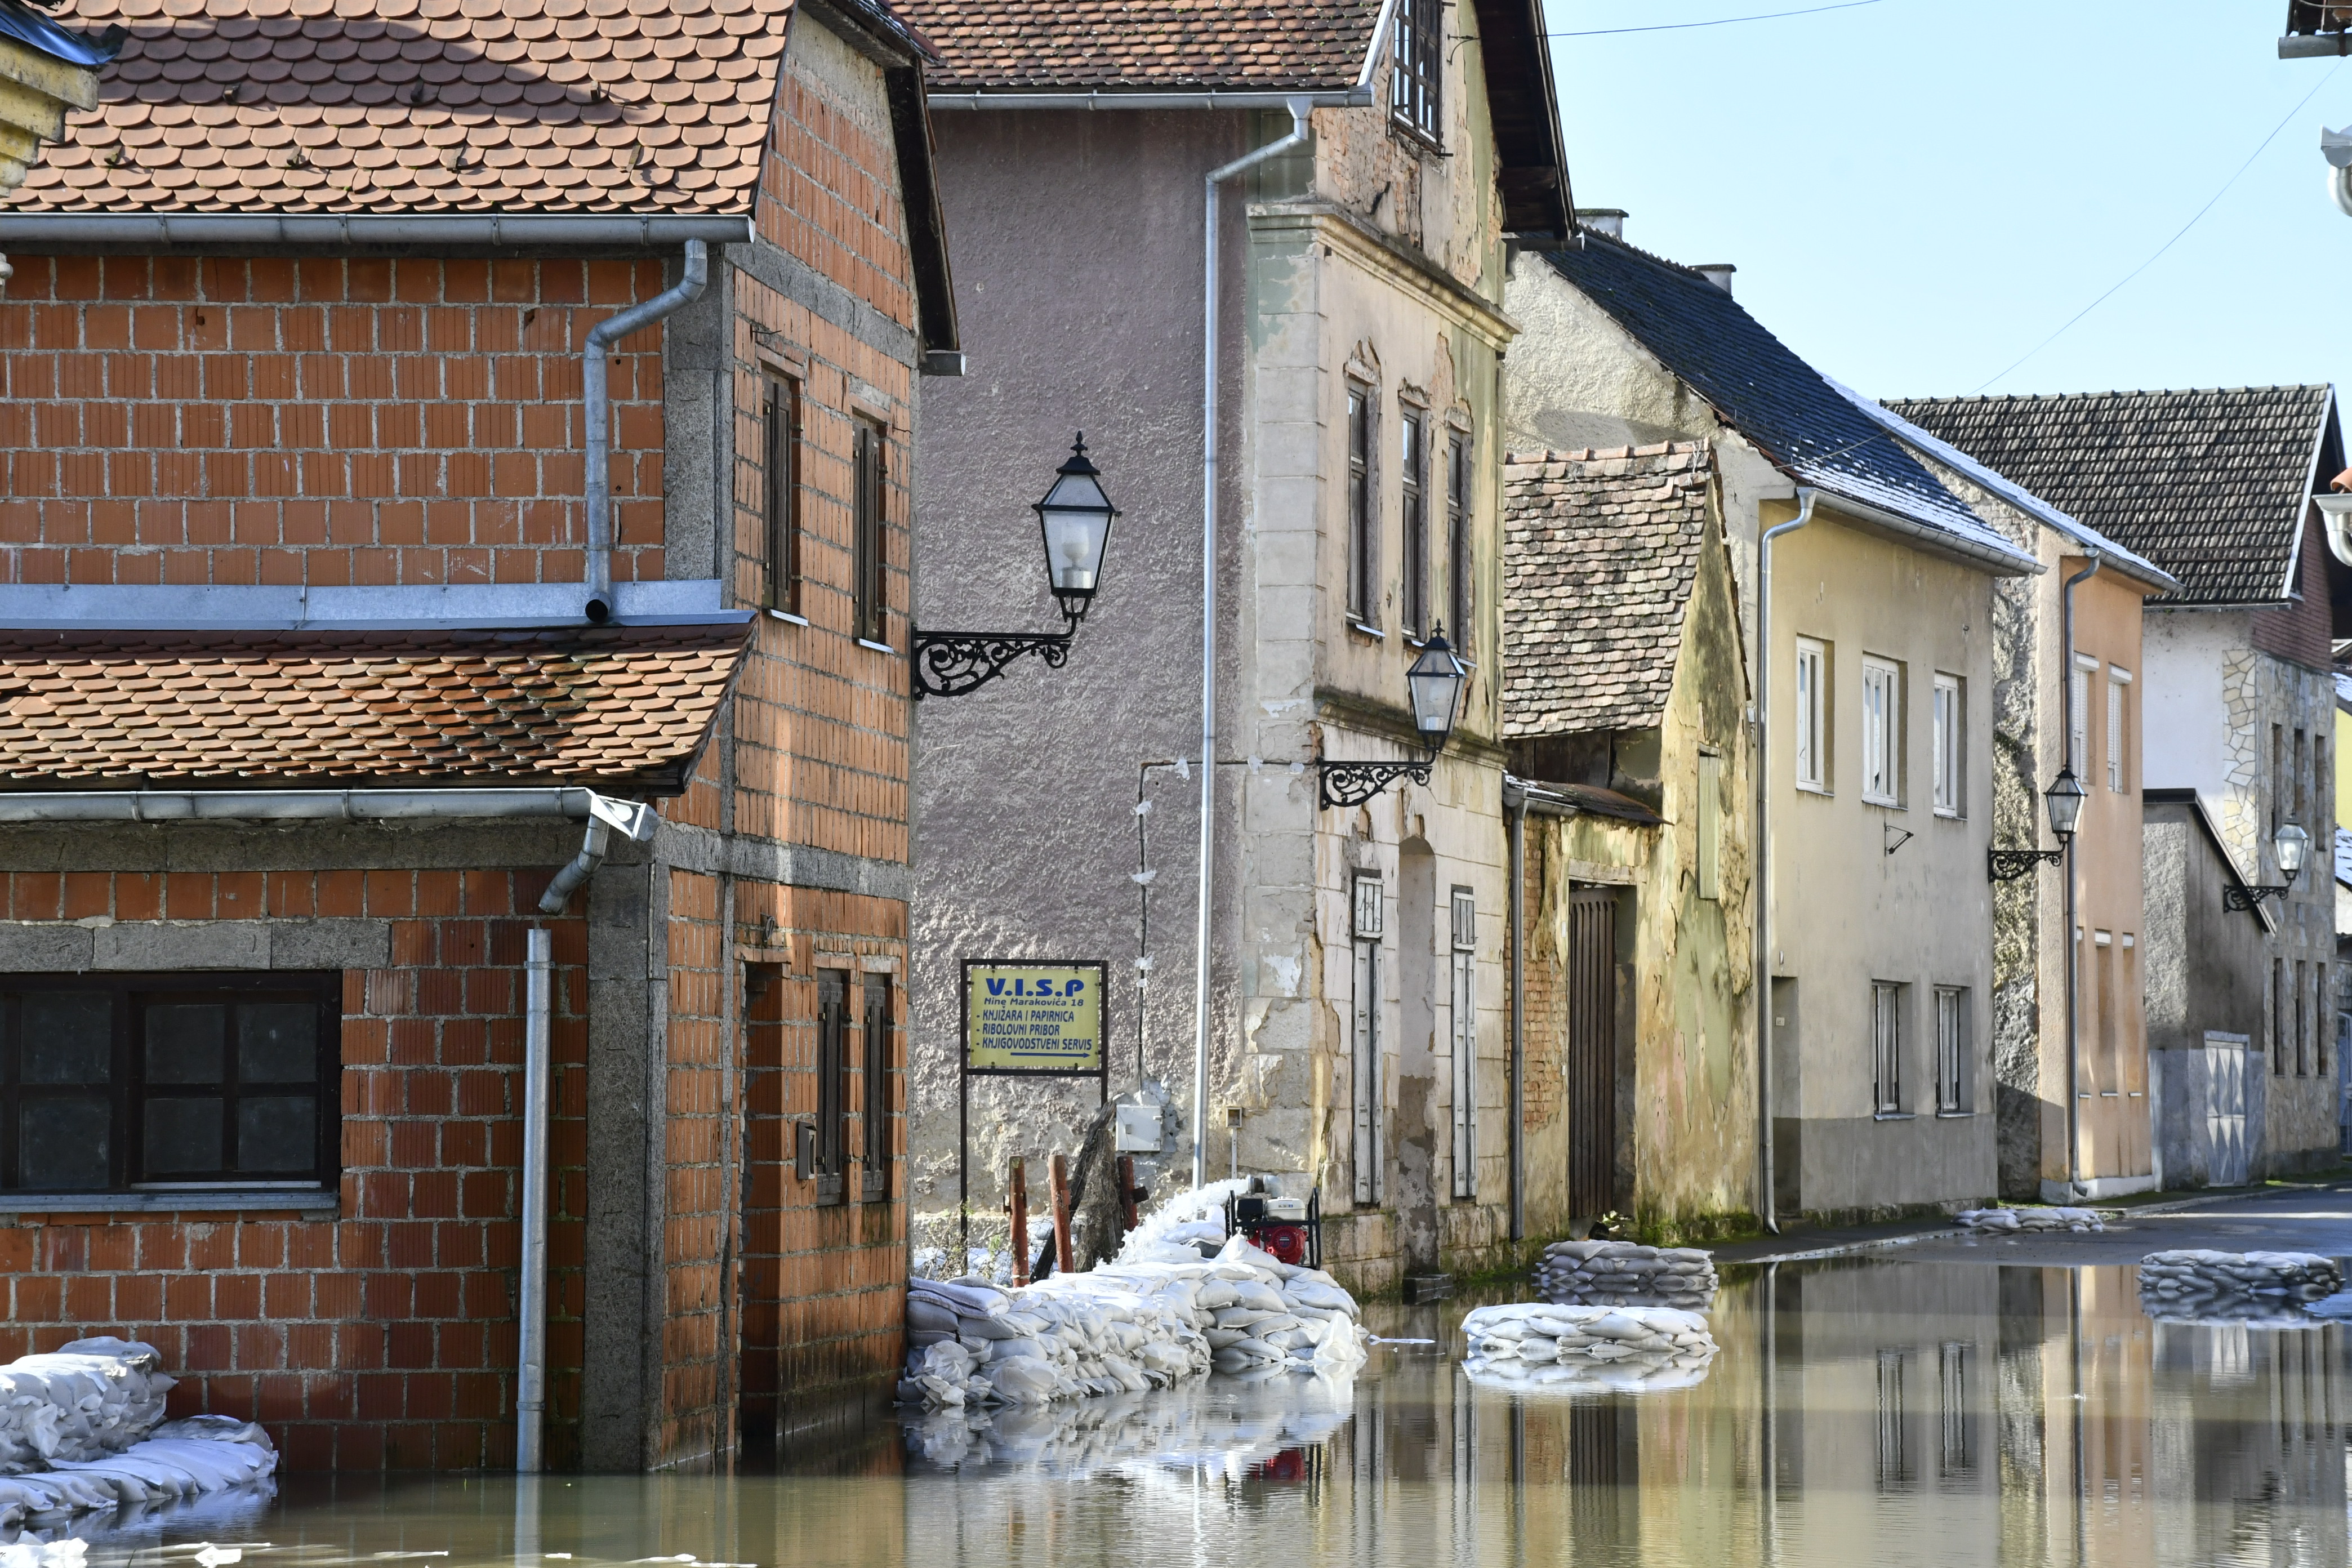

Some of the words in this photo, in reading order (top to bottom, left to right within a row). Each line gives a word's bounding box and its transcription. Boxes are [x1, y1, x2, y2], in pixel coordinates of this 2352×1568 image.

[986, 978, 1084, 997] V.I.S.P
[1010, 998, 1067, 1006] Marakovića
[982, 1005, 1023, 1022] KNJIŽARA
[1025, 1010, 1028, 1022] I
[1030, 1010, 1074, 1022] PAPIRNICA
[982, 1023, 1027, 1035] RIBOLOVNI
[1029, 1024, 1060, 1036] PRIBOR
[982, 1037, 1060, 1050] KNJIGOVODSTVENI
[1062, 1038, 1092, 1050] SERVIS
